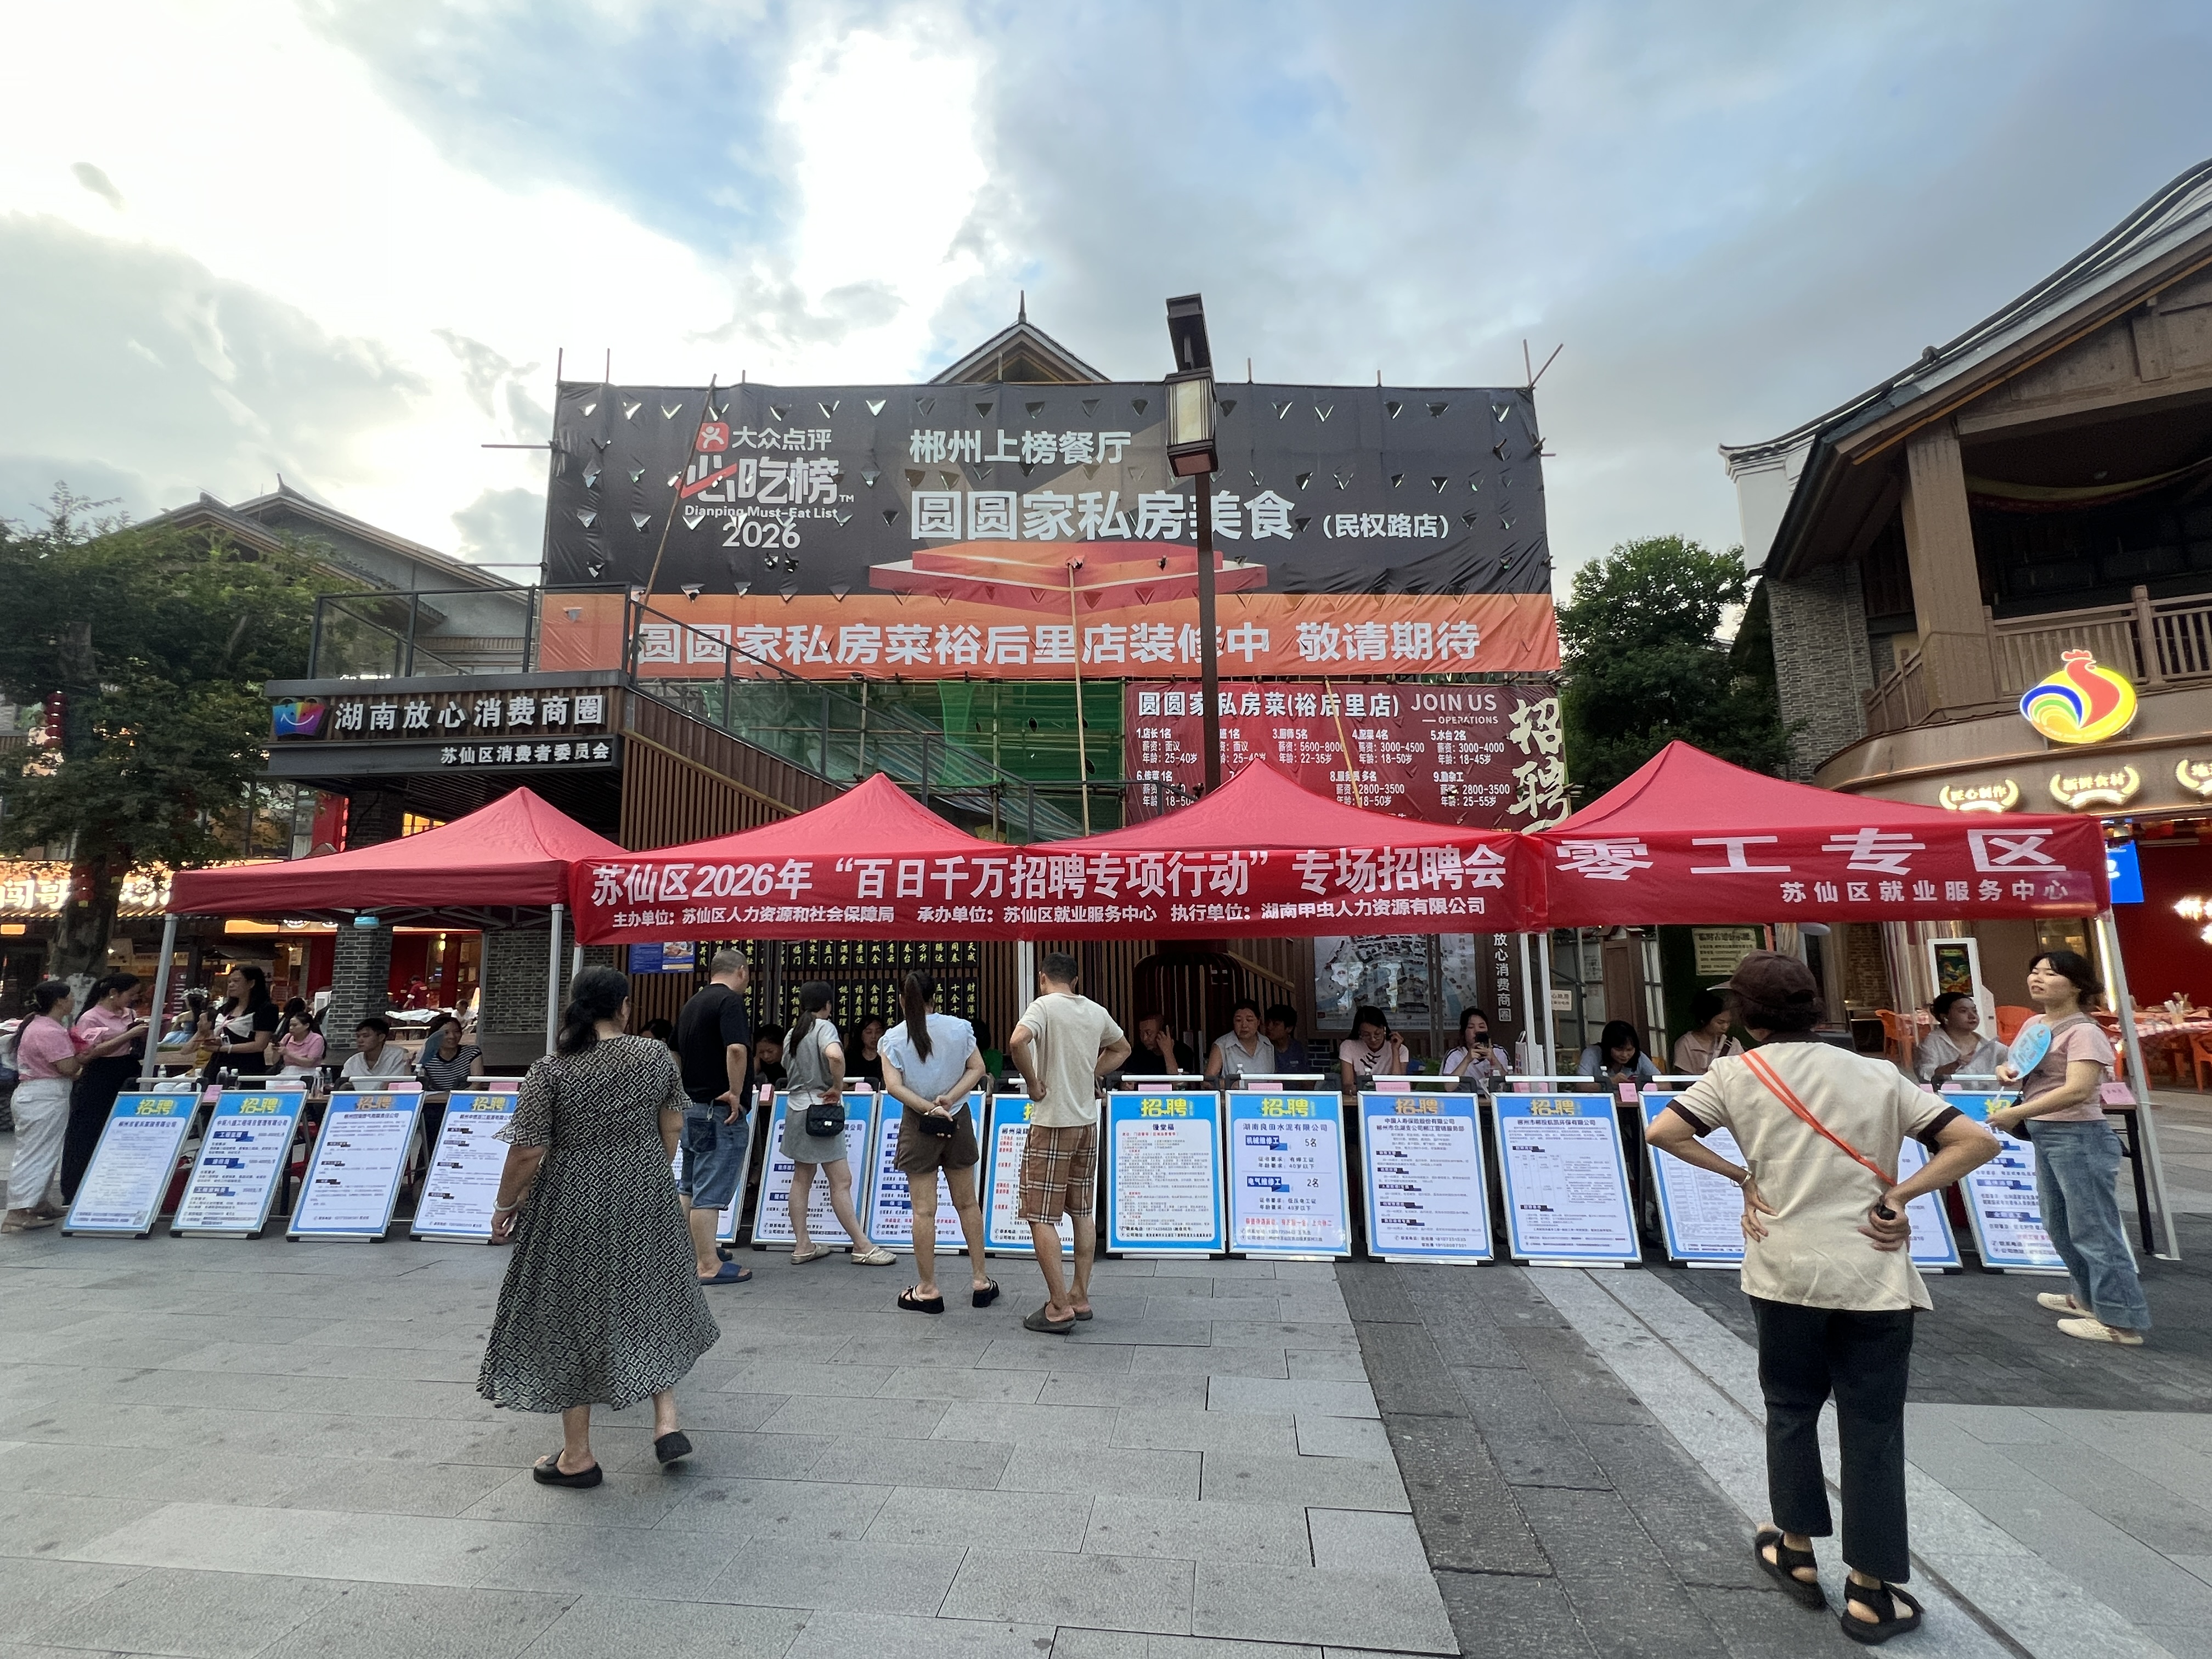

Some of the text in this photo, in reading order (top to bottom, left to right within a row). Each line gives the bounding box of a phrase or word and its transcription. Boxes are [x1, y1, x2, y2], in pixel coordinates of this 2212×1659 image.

[732, 426, 831, 451] 大众点评
[909, 429, 1131, 464] 郴州上榜餐厅
[674, 454, 839, 504] 必吃榜
[685, 505, 743, 517] Dianping
[814, 507, 837, 518] List
[911, 490, 1448, 540] 圆圆家私房美食 (民权路店)
[722, 521, 800, 548] 2026
[637, 620, 1480, 665] 圆圆家私房菜裕后里店装修中 敬请期待
[1138, 691, 1399, 718] 圆圆家私房菜(裕后里店)
[1411, 693, 1497, 711] JOIN US
[334, 695, 603, 731] 湖南放心消费商圈
[1438, 716, 1498, 724] OPERATIONS
[1160, 728, 1171, 739] 1名
[1295, 729, 1308, 740] 5名
[1376, 730, 1389, 740] 4名
[1454, 730, 1466, 741] 2名
[441, 741, 610, 765] 苏仙区消费者委员会
[1161, 770, 1172, 782] 1名
[1506, 697, 1568, 836] 招聘
[1555, 827, 2066, 881] 零工专区
[592, 843, 1506, 906] 苏仙区2026年 “百日千万招聘专项行动” 专场招聘会
[0, 879, 71, 910] 闯哥
[1780, 879, 2067, 903] 苏仙区就业服务中心
[613, 896, 1485, 929] 主办单位：苏仙区人力资源和社会保障局 承办单位：苏仙区就业服务中心 执行单位：湖南甲虫人力资源有限公司
[136, 1099, 174, 1115] 招聘
[239, 1098, 278, 1114] 招聘
[472, 1097, 505, 1111] 招聘
[1141, 1098, 1187, 1117] 招聘
[1261, 1098, 1308, 1117] 招聘
[1395, 1098, 1438, 1115] 招聘
[1530, 1099, 1575, 1116] 招聘
[1305, 1138, 1317, 1147] 5名
[1307, 1178, 1319, 1187] 2名
